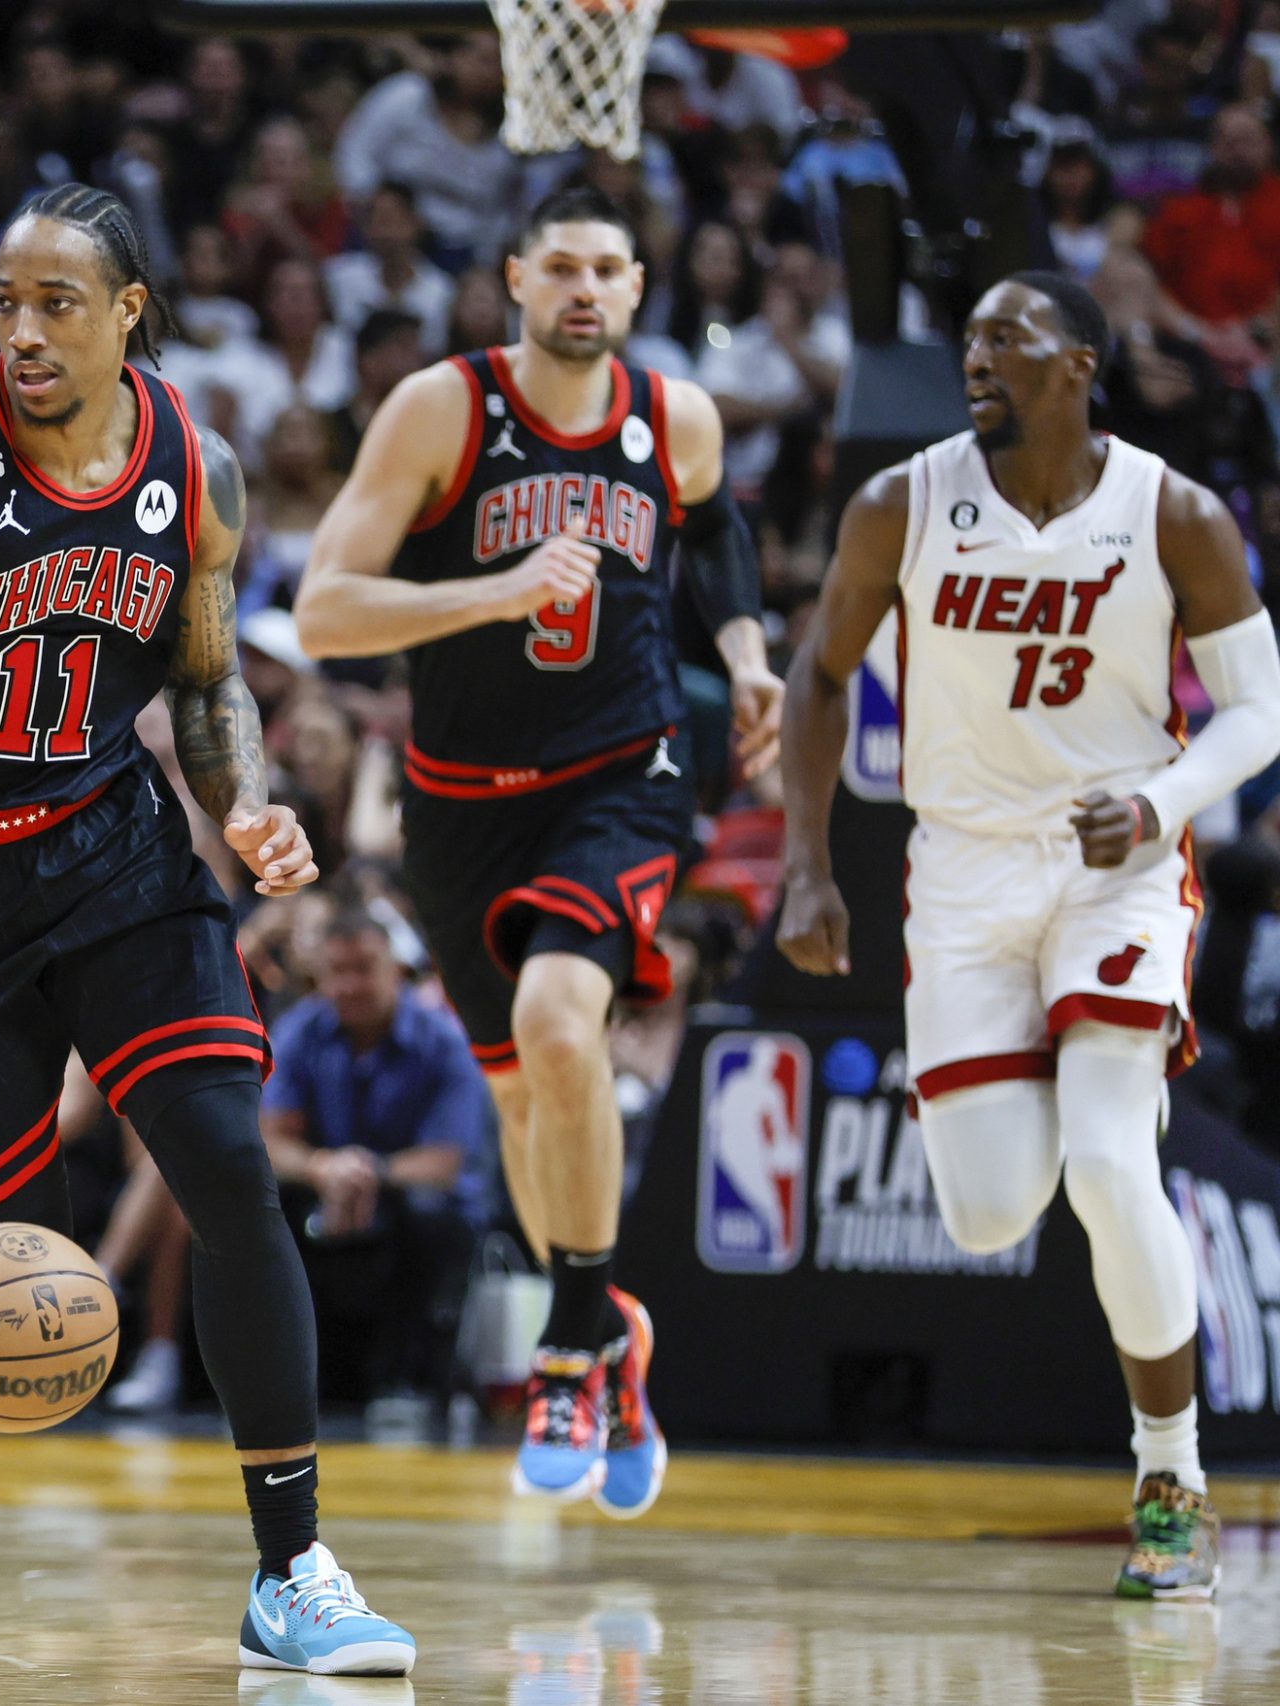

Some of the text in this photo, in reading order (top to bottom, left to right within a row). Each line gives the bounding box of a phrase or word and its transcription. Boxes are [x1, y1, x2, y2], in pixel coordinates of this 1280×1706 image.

[474, 472, 658, 573] CHICAGO
[525, 575, 602, 671] 9
[932, 556, 1126, 636] HEAT
[1009, 644, 1095, 709] 13
[817, 1097, 931, 1205] PLA
